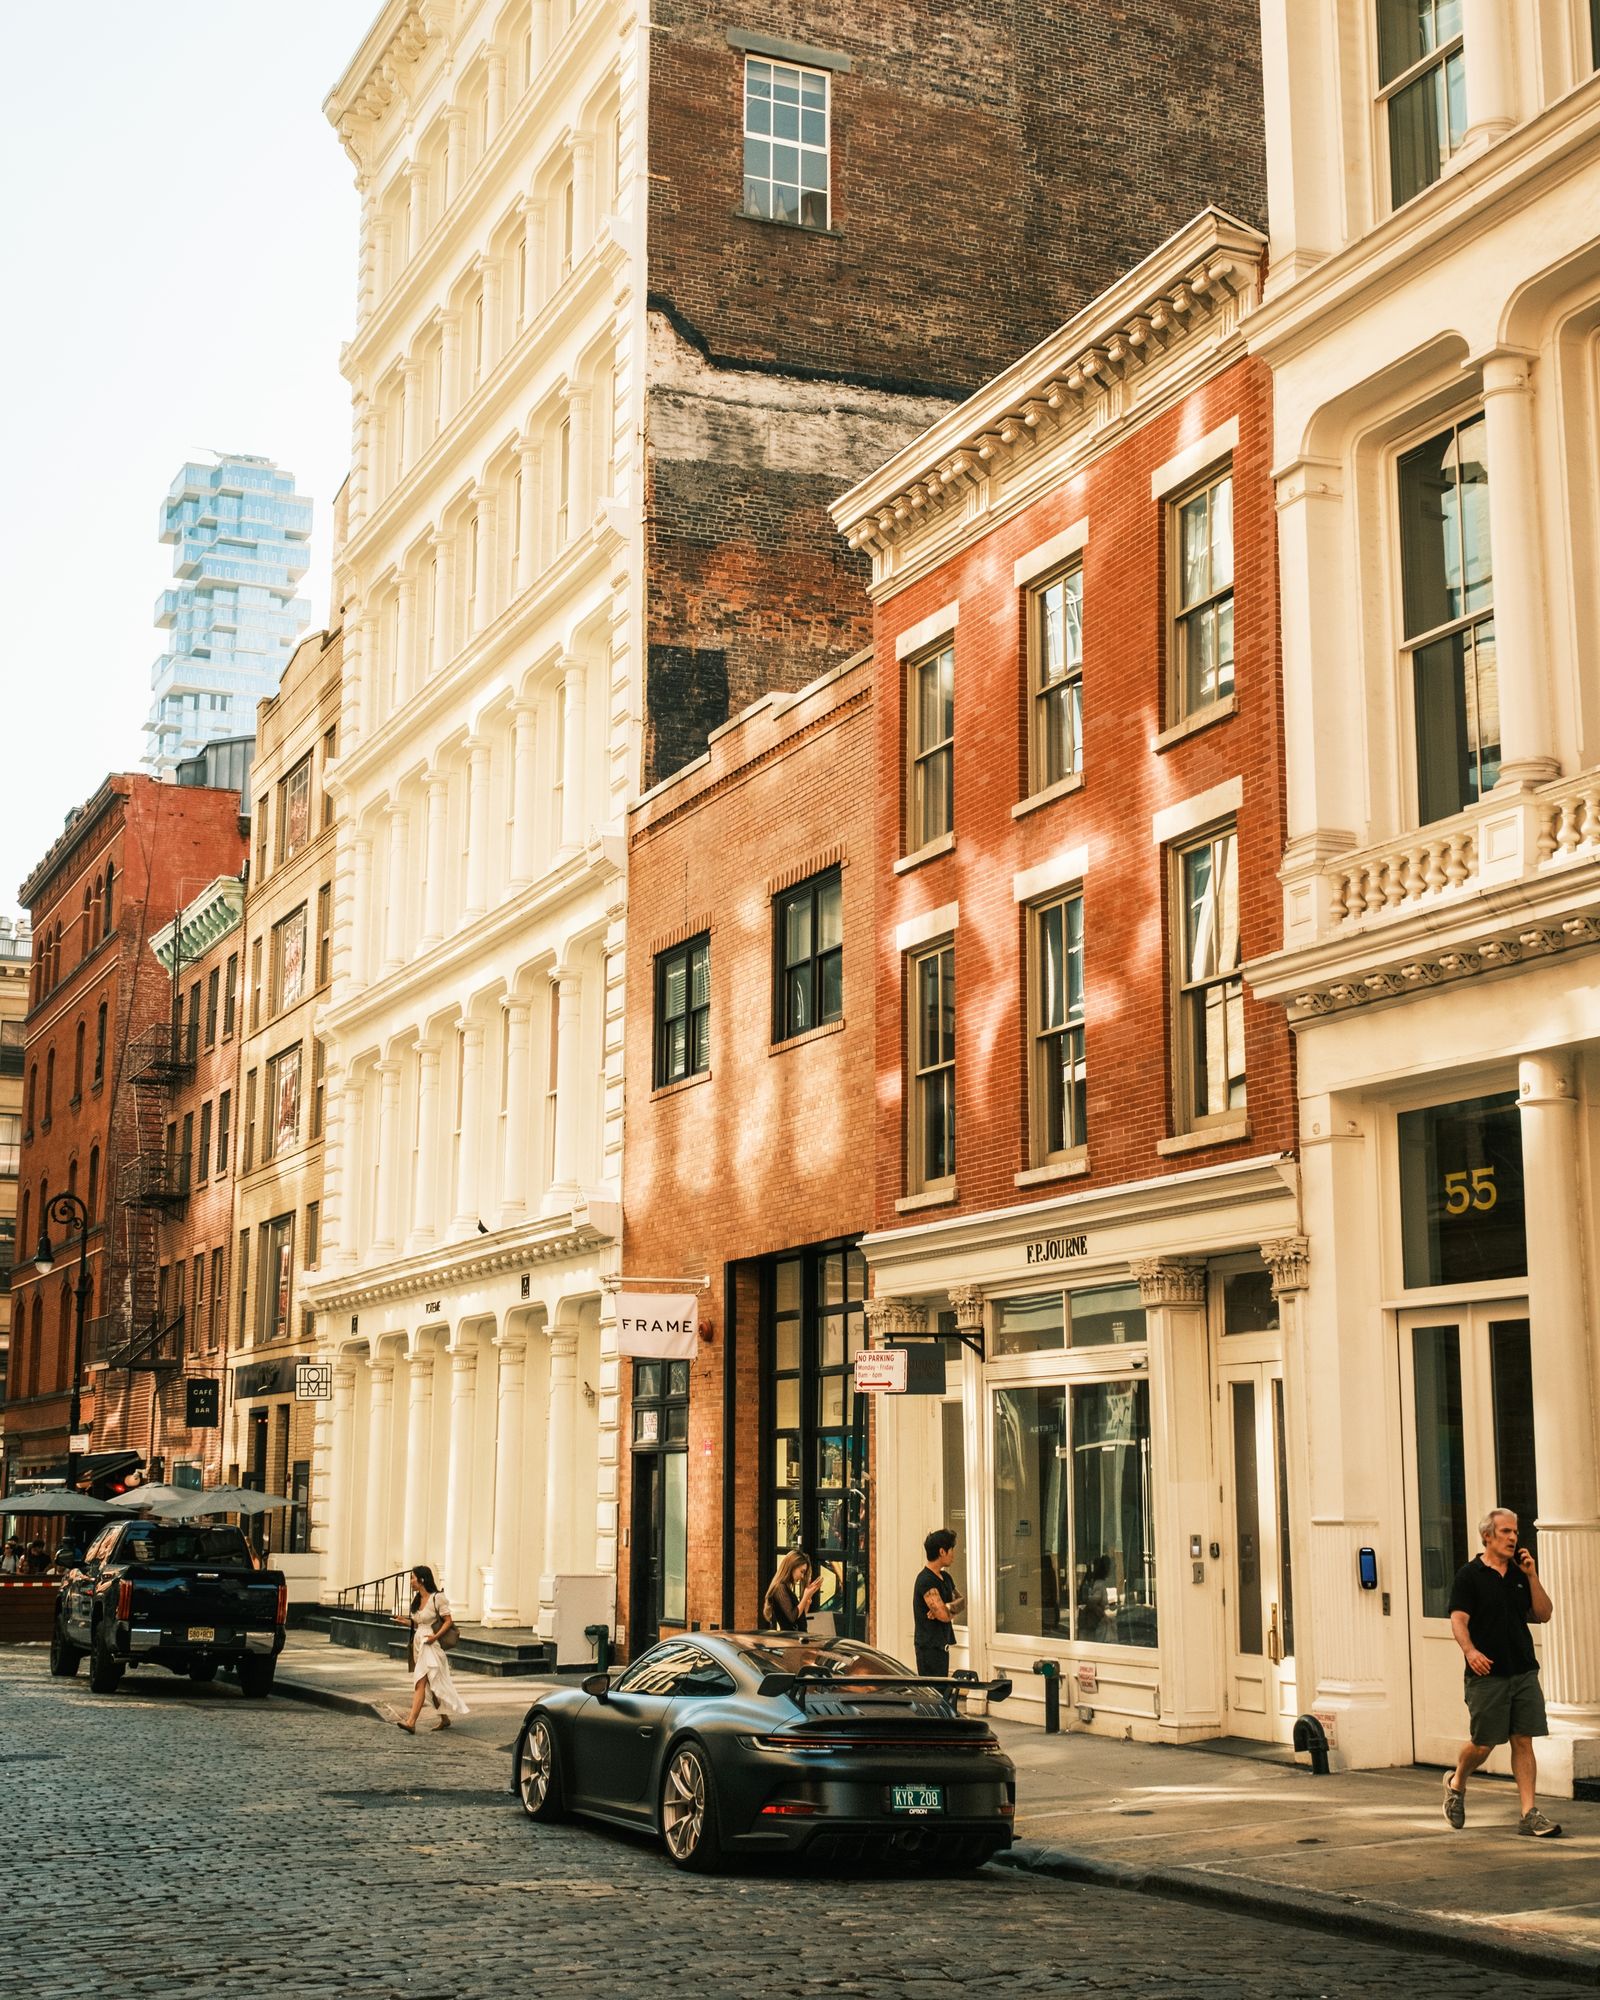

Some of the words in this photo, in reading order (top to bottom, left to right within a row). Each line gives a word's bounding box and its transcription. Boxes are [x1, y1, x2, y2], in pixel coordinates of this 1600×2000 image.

[1445, 1165, 1497, 1214] 55
[622, 1318, 693, 1333] FRAME
[858, 1354, 867, 1362] NO
[868, 1354, 895, 1362] PARKING
[880, 1363, 894, 1371] Friday
[193, 1388, 213, 1396] CAFÉ
[895, 1791, 914, 1806] KYR
[919, 1791, 938, 1806] 208
